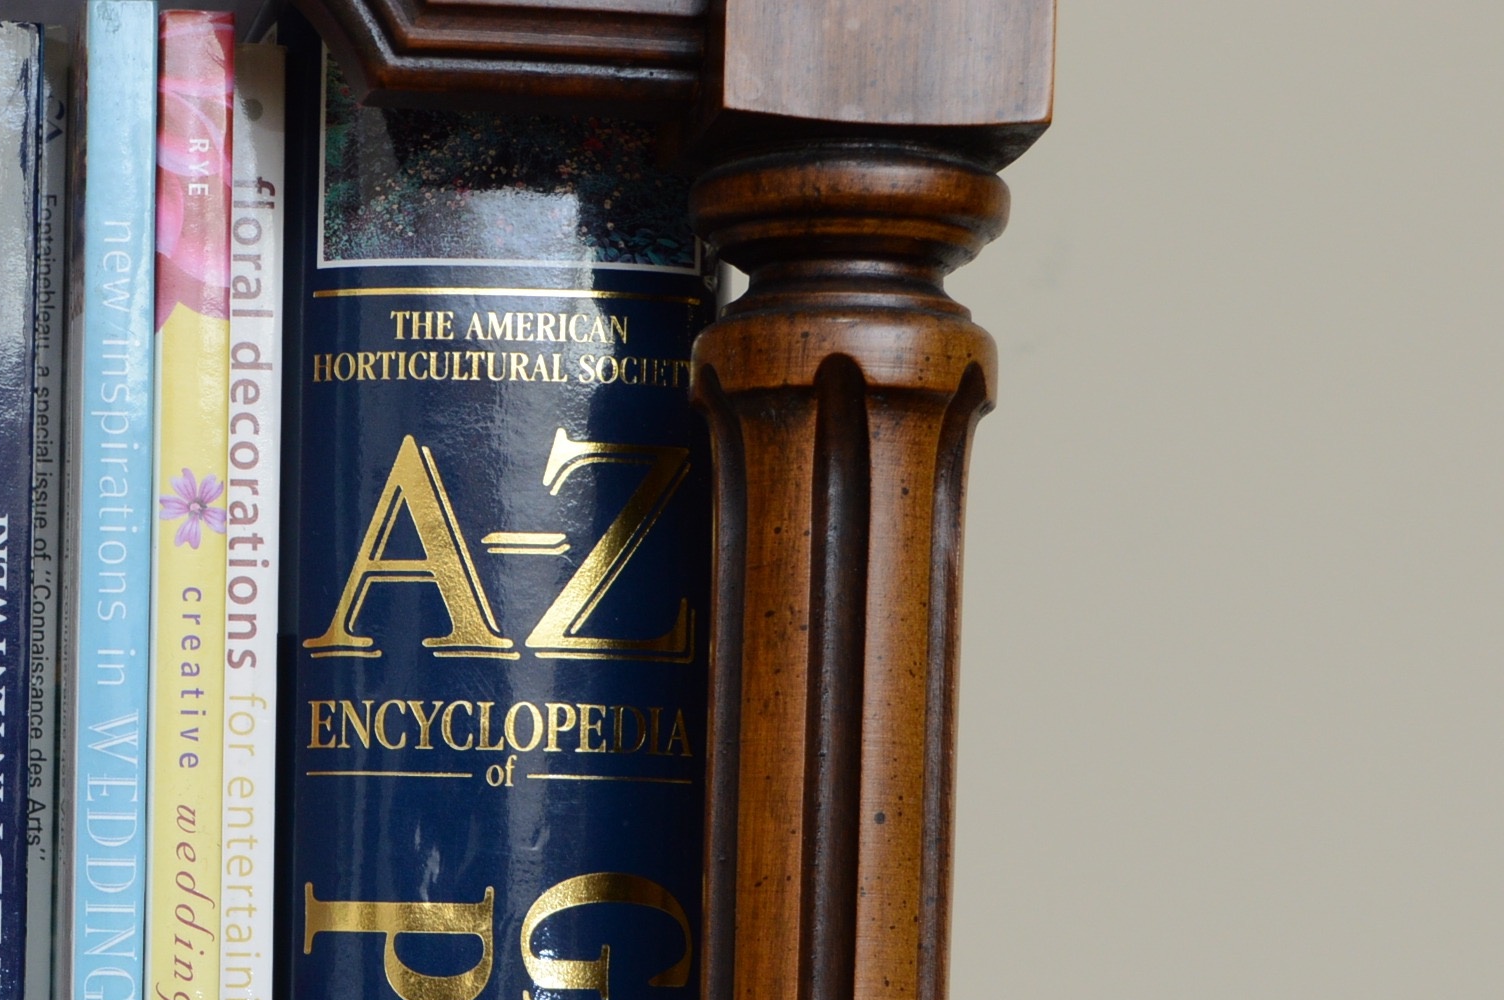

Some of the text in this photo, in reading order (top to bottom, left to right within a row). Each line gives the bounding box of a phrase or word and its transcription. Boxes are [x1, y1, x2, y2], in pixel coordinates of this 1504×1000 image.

[187, 137, 210, 197] RYE
[101, 219, 133, 314] new
[232, 176, 277, 319] floral
[390, 310, 629, 345] THE AMERICAN
[36, 366, 50, 378] a
[312, 351, 569, 383] HORTICULTURAL
[35, 386, 54, 463] special
[34, 471, 54, 529] issue
[90, 338, 141, 622] inspirations
[226, 343, 274, 671] decorations
[33, 537, 52, 562] of
[96, 648, 137, 687] in
[178, 586, 207, 770] creative
[224, 692, 267, 757] for
[306, 699, 693, 758] ENCYCLOPEDIA
[28, 748, 48, 788] des
[485, 755, 518, 788] of
